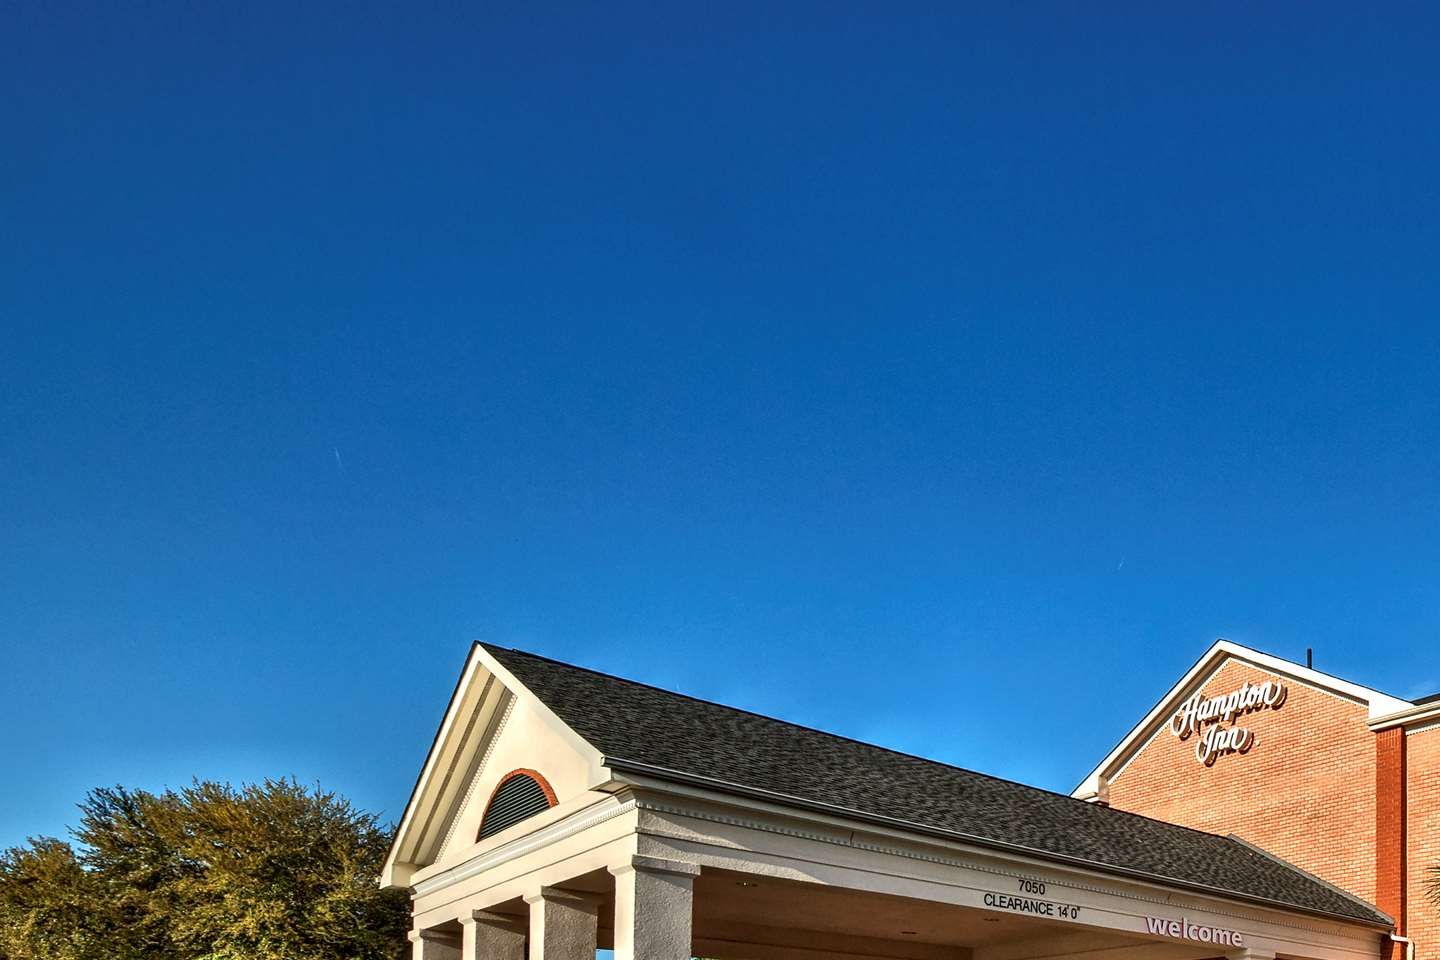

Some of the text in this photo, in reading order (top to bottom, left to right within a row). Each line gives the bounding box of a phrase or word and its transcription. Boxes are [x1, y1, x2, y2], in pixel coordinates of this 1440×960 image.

[1171, 681, 1283, 736] Hampton
[1196, 724, 1249, 763] Inn
[1018, 880, 1046, 895] 7050
[984, 893, 1054, 916] CLEARANCE
[1146, 916, 1243, 947] welcome
